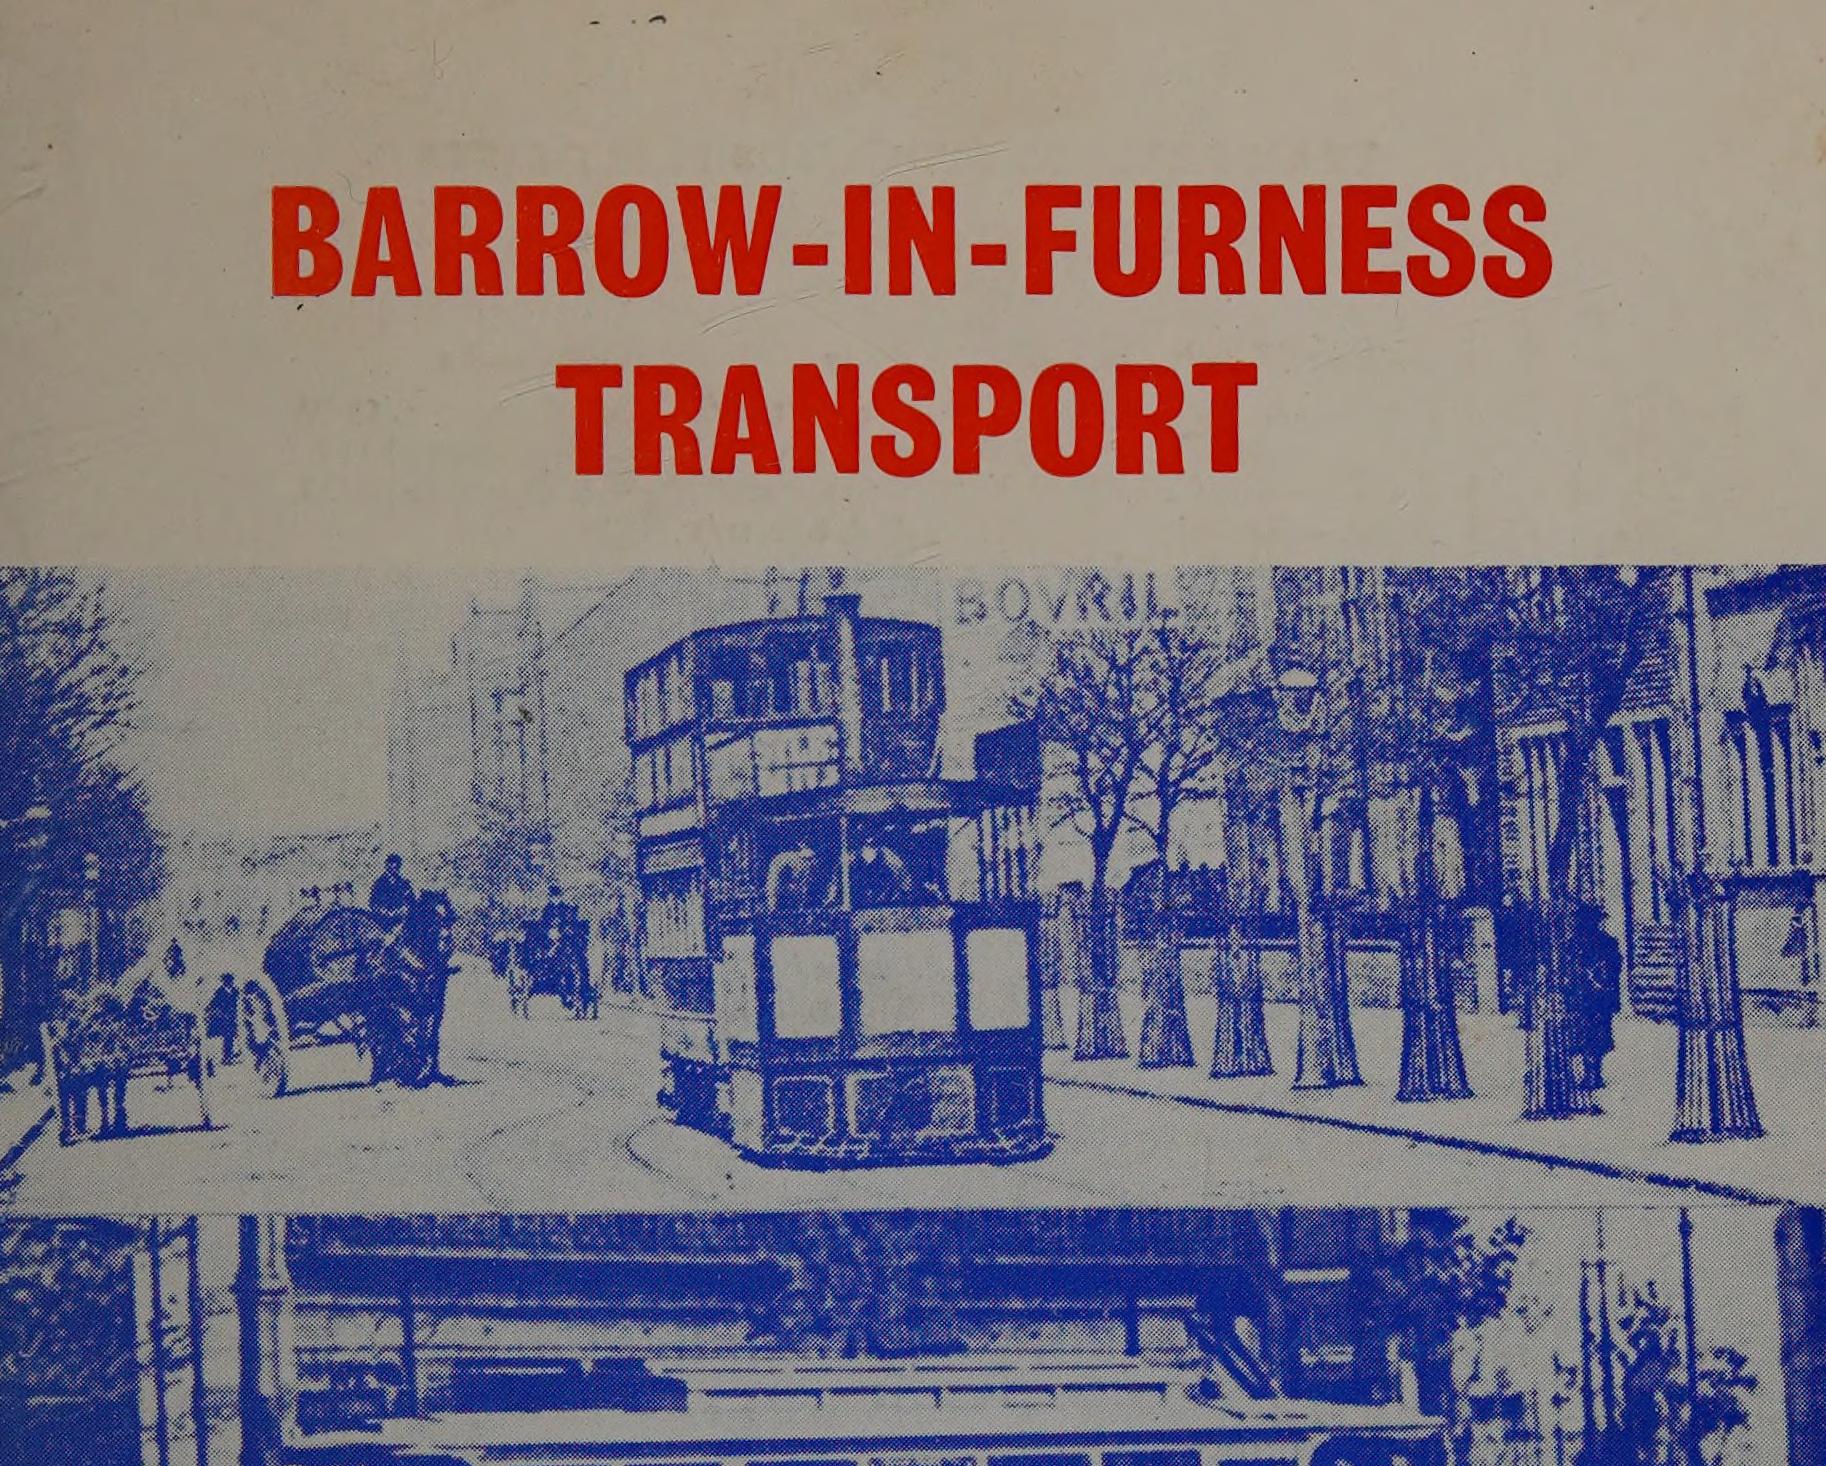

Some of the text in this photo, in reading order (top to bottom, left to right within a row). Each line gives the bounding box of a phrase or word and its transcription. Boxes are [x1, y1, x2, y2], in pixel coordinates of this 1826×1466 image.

[271, 183, 1552, 299] BARROW-IN-FURNESS
[555, 362, 1258, 478] TRANSPORT
[953, 571, 1178, 625] BOVRIL
